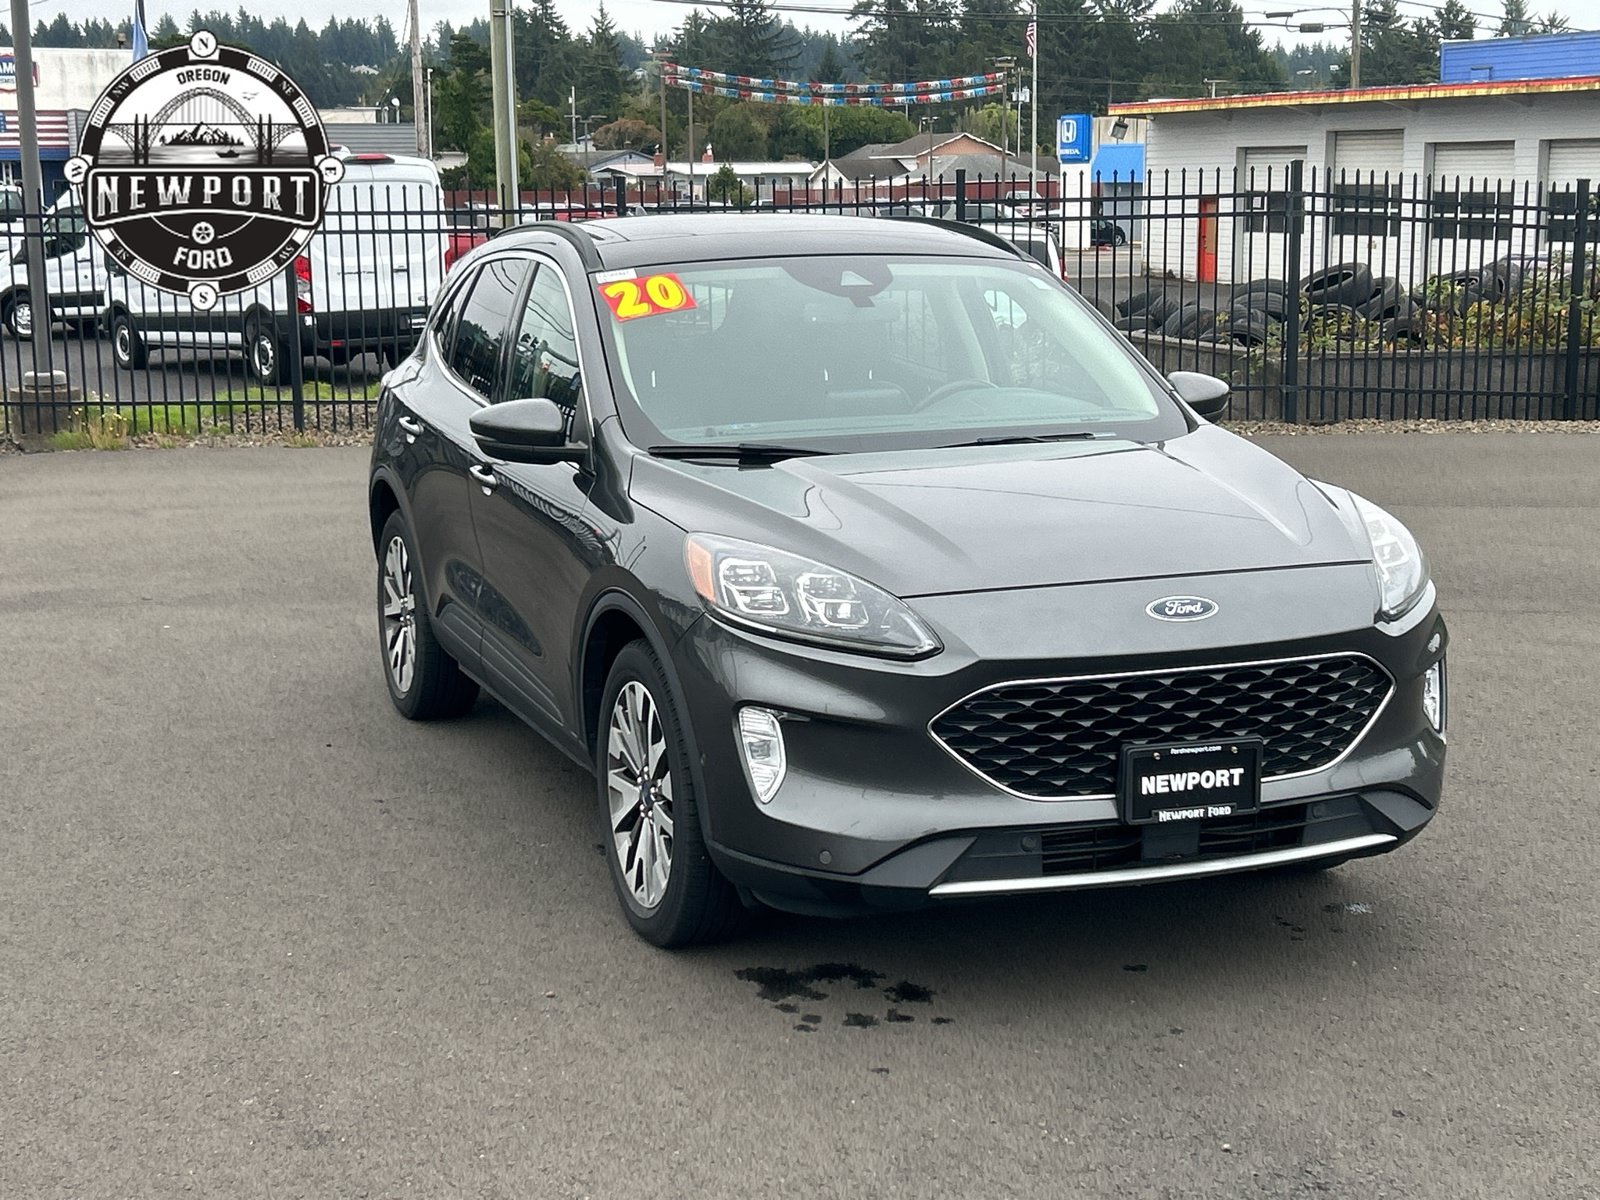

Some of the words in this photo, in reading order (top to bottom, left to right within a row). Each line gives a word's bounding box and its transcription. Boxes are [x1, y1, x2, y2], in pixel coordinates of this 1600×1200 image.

[604, 275, 686, 318] 20
[1165, 599, 1204, 616] Ford
[1141, 767, 1245, 796] NEWPORT
